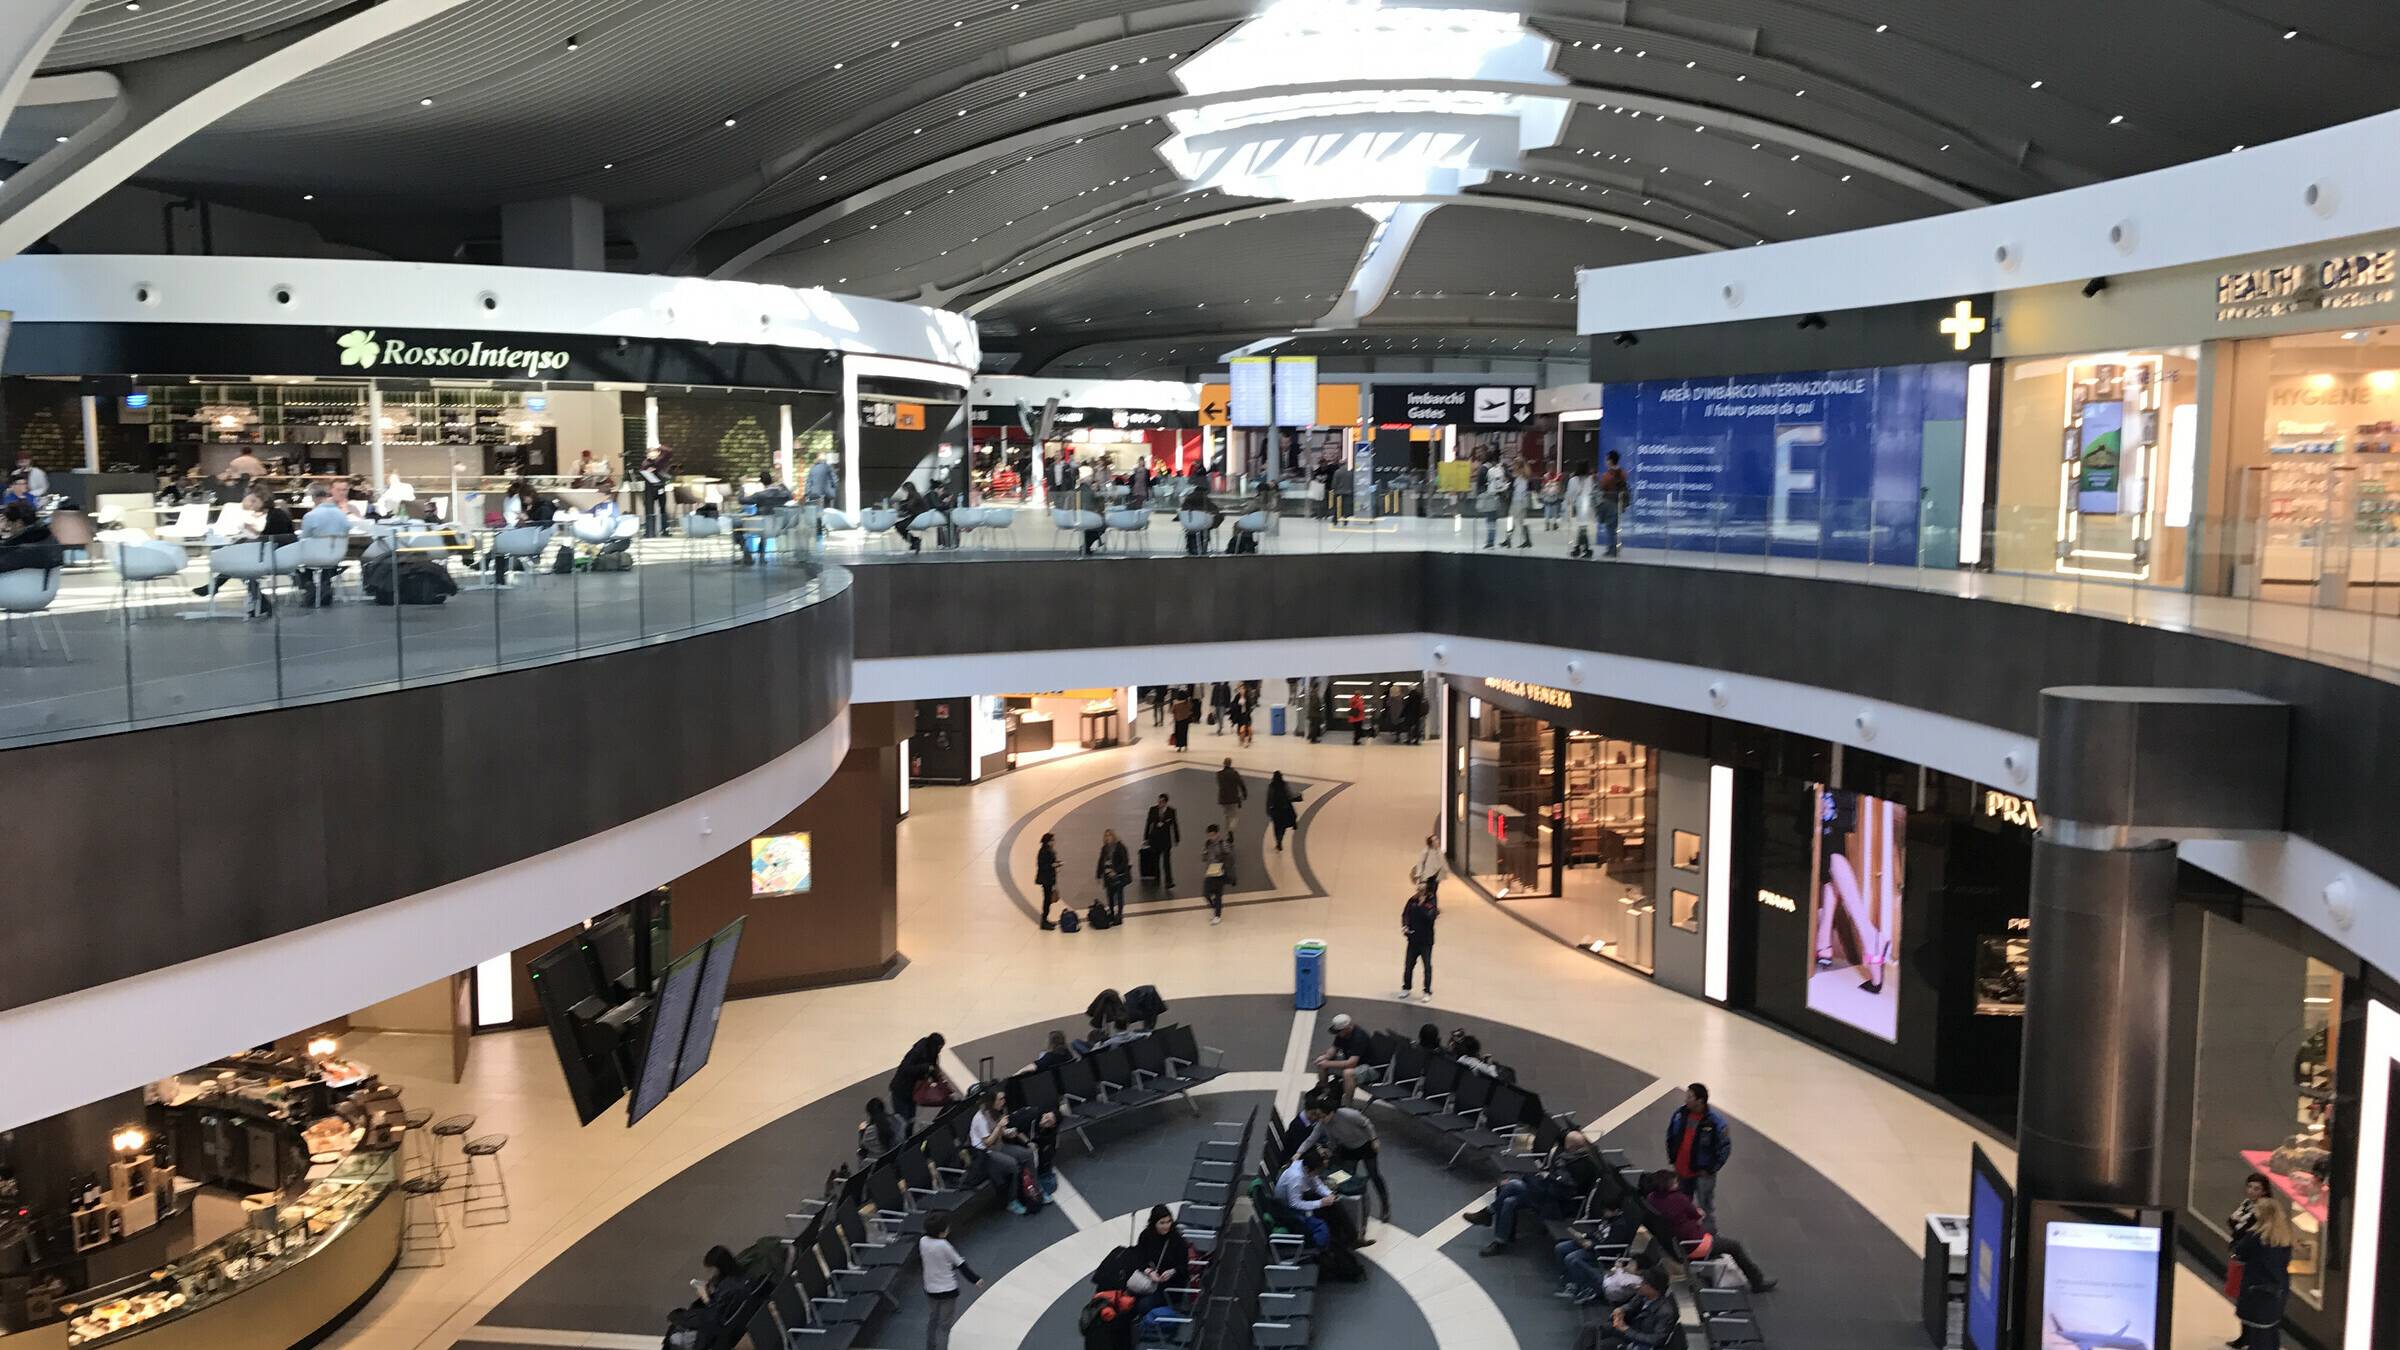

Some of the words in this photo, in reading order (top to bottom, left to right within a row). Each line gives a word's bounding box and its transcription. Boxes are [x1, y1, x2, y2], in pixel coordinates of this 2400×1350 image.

[2216, 264, 2303, 304] HEALTH
[2319, 250, 2396, 290] CARE
[1407, 391, 1466, 405] Imbarchi
[1659, 386, 1692, 402] AREA
[1759, 378, 1866, 399] INTERNAZIONALE
[1407, 406, 1446, 419] Gates
